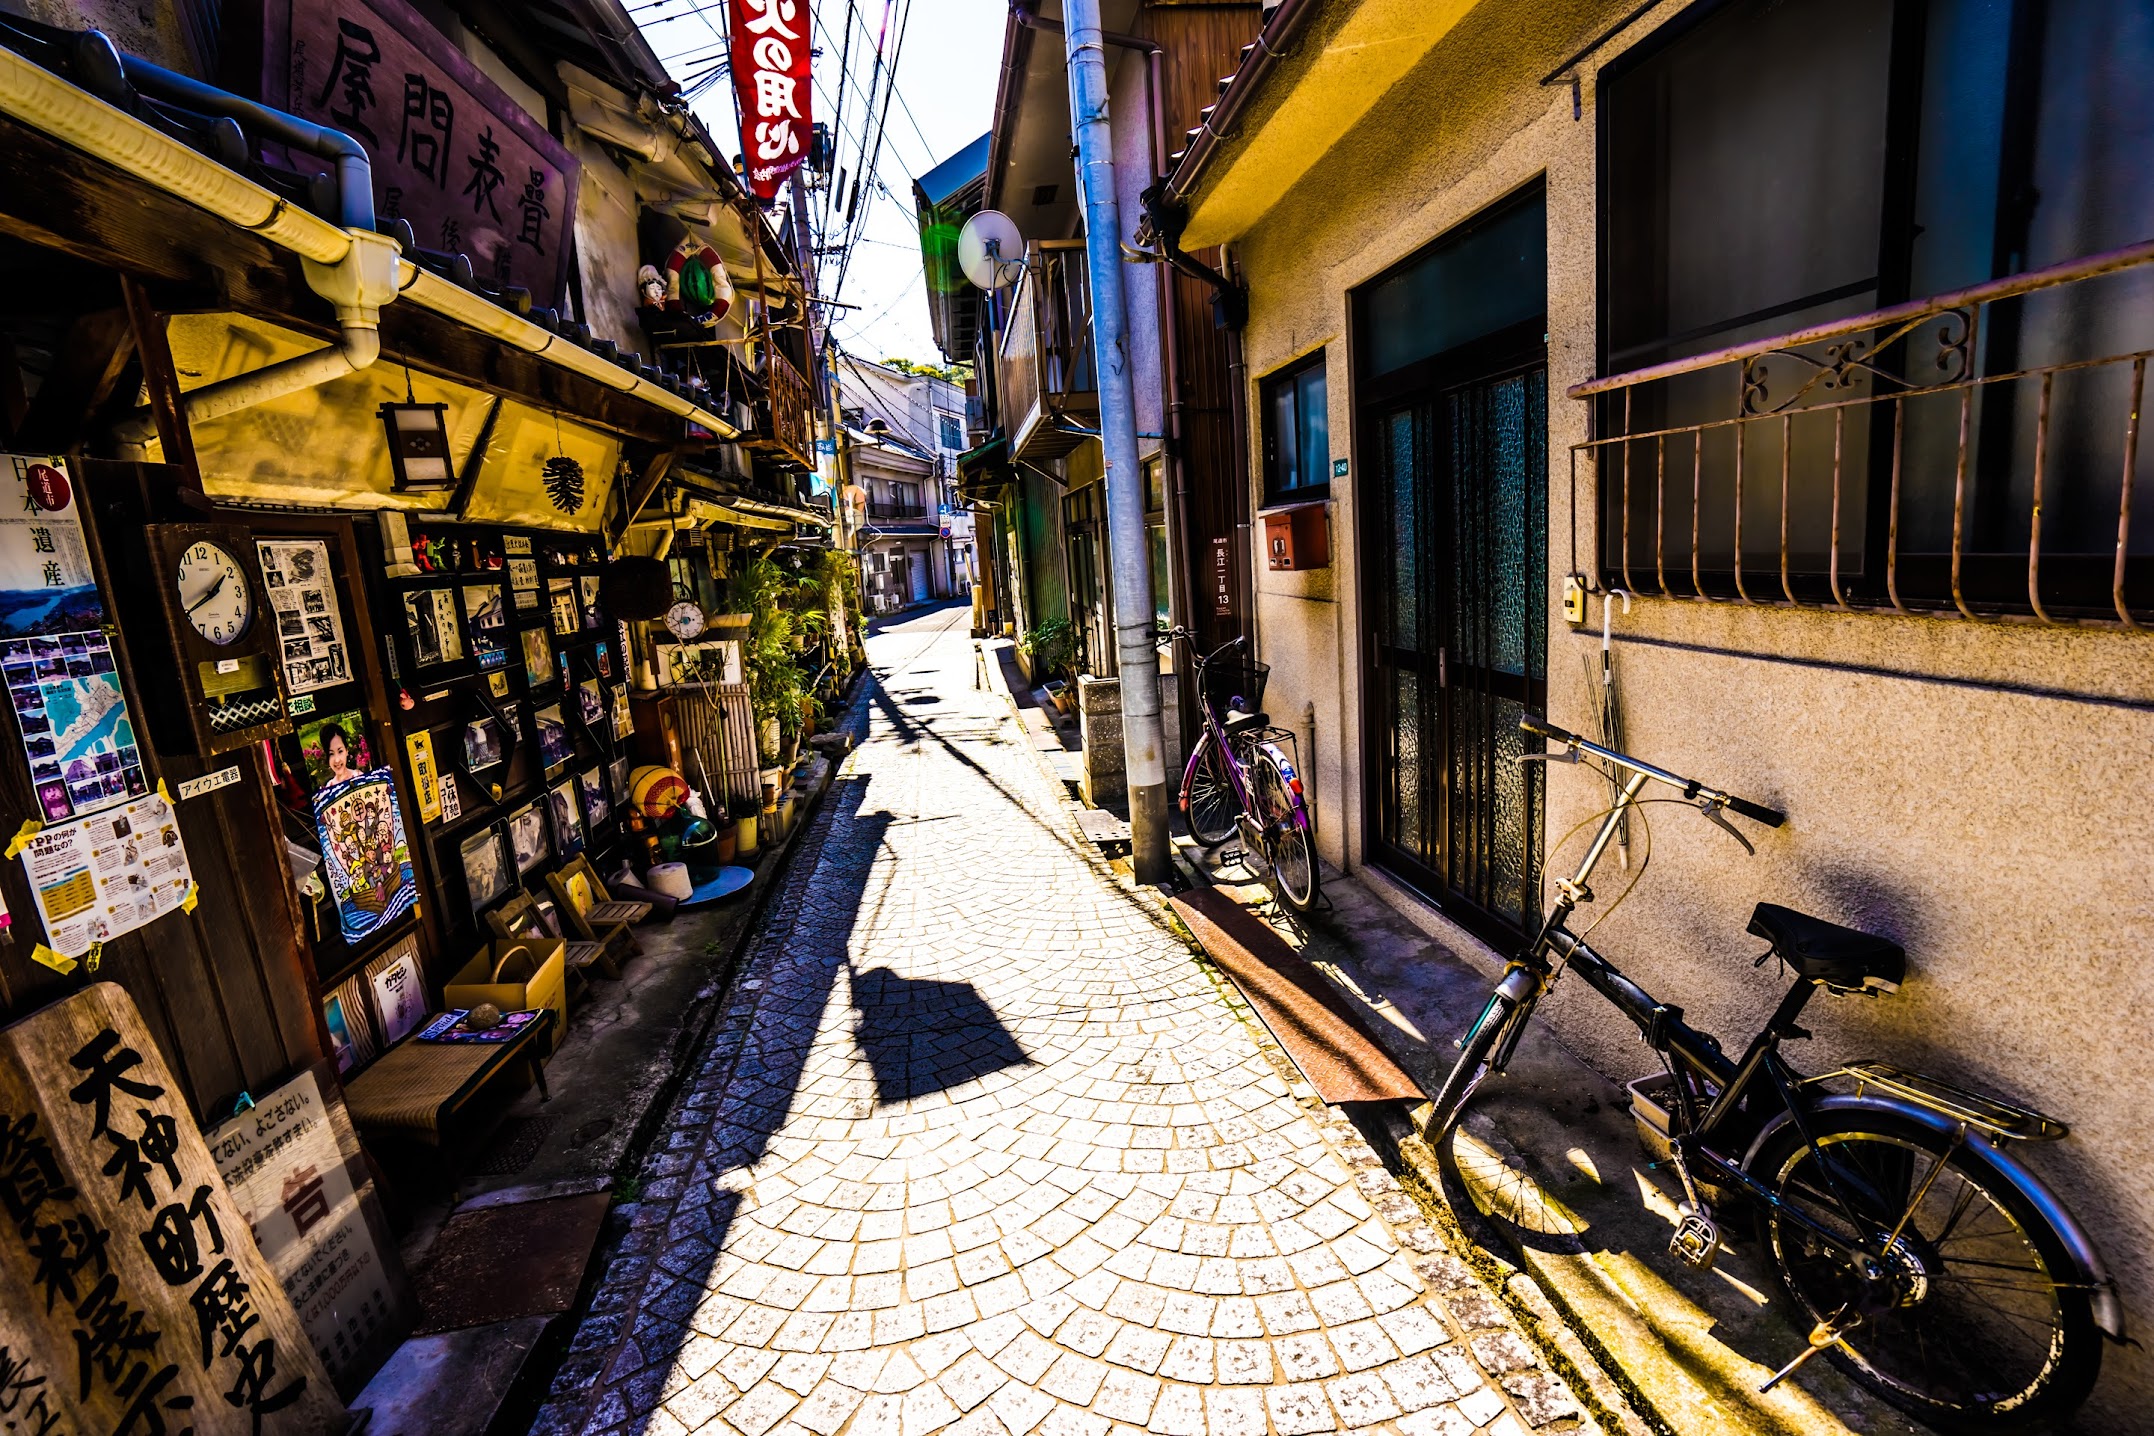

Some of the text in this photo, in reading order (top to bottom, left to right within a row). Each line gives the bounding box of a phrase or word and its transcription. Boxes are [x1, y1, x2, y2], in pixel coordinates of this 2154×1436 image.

[37, 468, 55, 508] 尾道市
[12, 456, 65, 587] 日本遺産
[195, 546, 208, 560] 12
[214, 552, 220, 565] 1
[226, 566, 235, 579] 2
[1216, 548, 1226, 593] 長江一丁目
[234, 585, 243, 599] 3
[1217, 594, 1229, 605] 13
[234, 605, 242, 619] 4
[198, 623, 206, 639] 7
[213, 626, 222, 640] 6
[227, 621, 236, 634] 5
[181, 768, 239, 797] アイウエ電器
[417, 761, 432, 806] 取扱店
[70, 1028, 307, 1436] 天神町歴史
